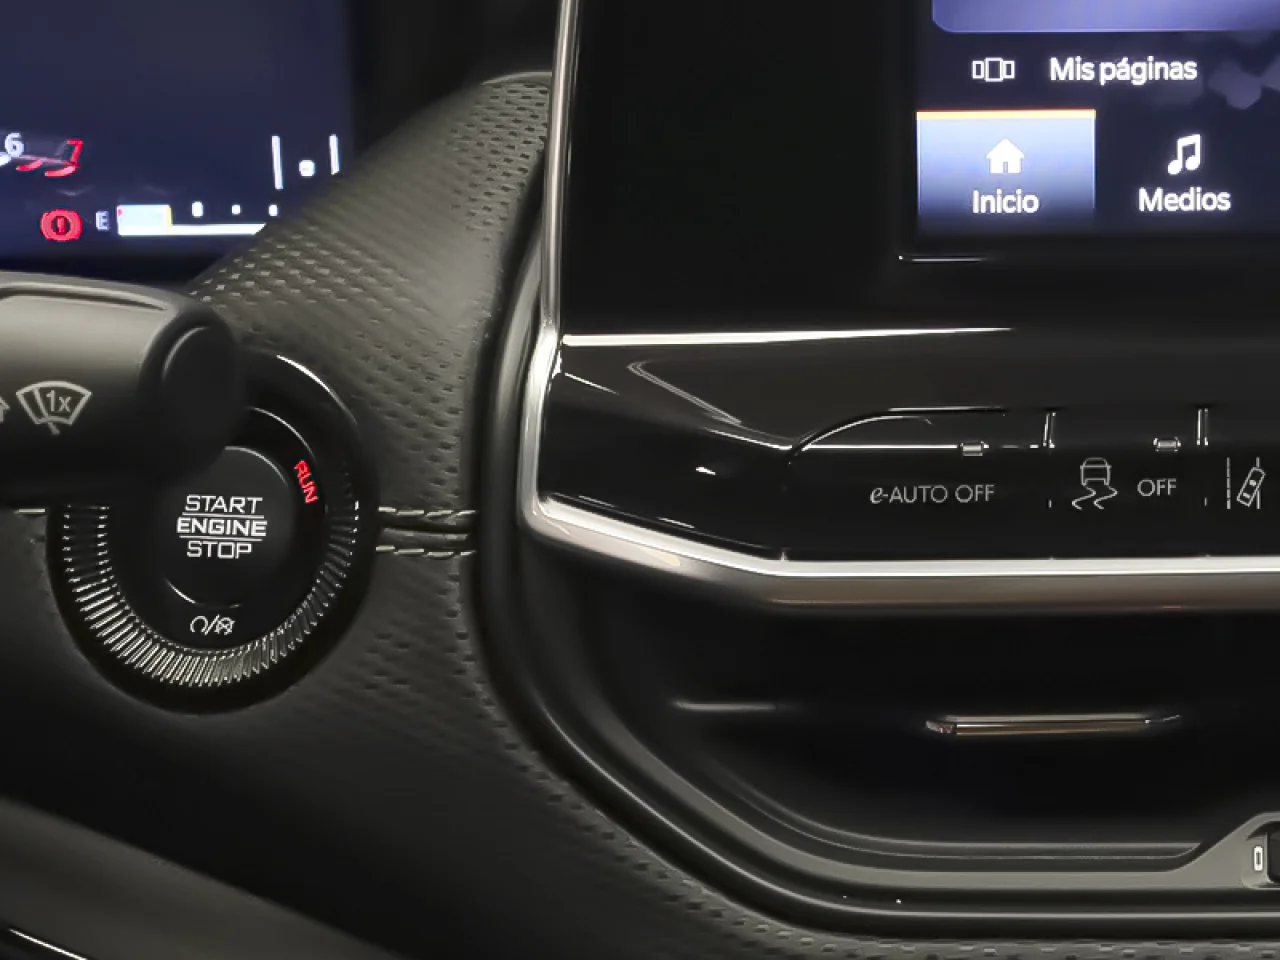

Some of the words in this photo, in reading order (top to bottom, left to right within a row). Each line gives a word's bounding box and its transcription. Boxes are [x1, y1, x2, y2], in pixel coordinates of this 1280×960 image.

[1049, 56, 1095, 80] Mis
[1098, 56, 1198, 85] páginas
[972, 190, 1039, 214] Inicio
[1138, 187, 1231, 212] Medios
[95, 211, 109, 230] E
[46, 390, 72, 412] 1x
[294, 460, 318, 504] RUN
[1137, 478, 1177, 497] OFF
[185, 495, 263, 514] START
[869, 484, 948, 505] e-AUTO
[954, 484, 995, 503] OFF
[176, 517, 268, 536] ENGINE
[186, 540, 252, 559] STOP
